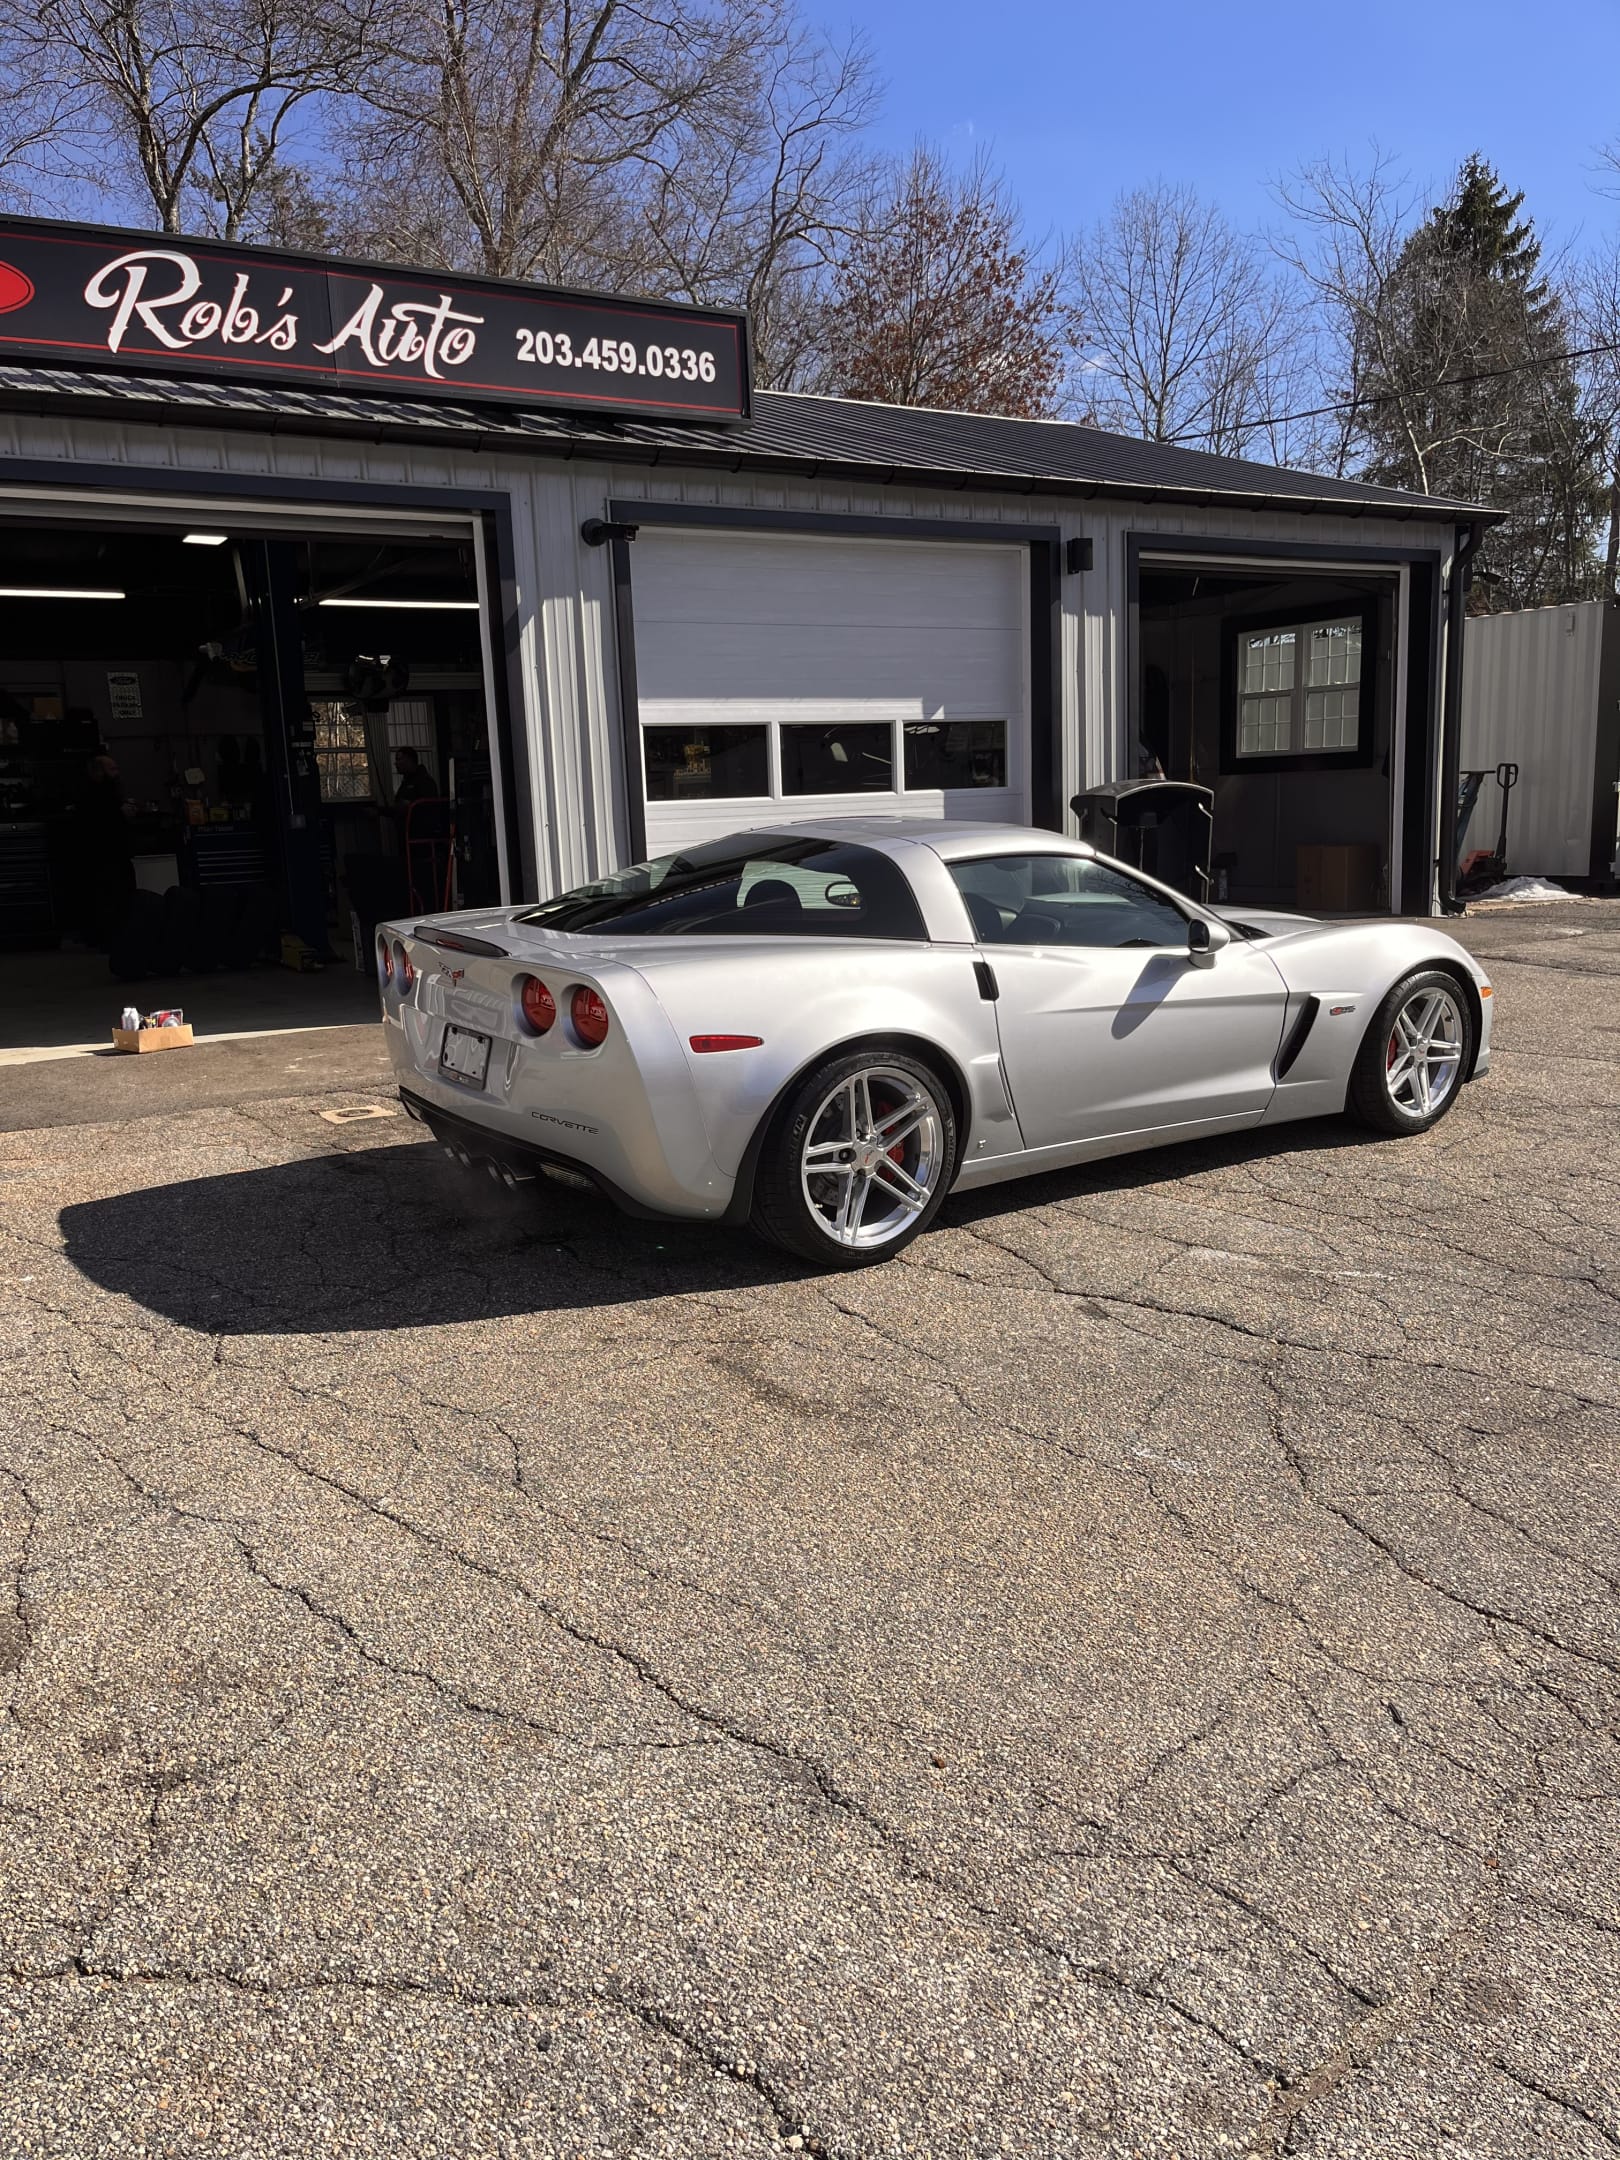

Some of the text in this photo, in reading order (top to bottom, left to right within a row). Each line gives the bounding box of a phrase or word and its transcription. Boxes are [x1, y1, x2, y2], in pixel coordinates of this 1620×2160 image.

[84, 250, 485, 379] Rob's Auto
[516, 328, 716, 383] 203.459.0336
[531, 1111, 600, 1135] CORVETTE
